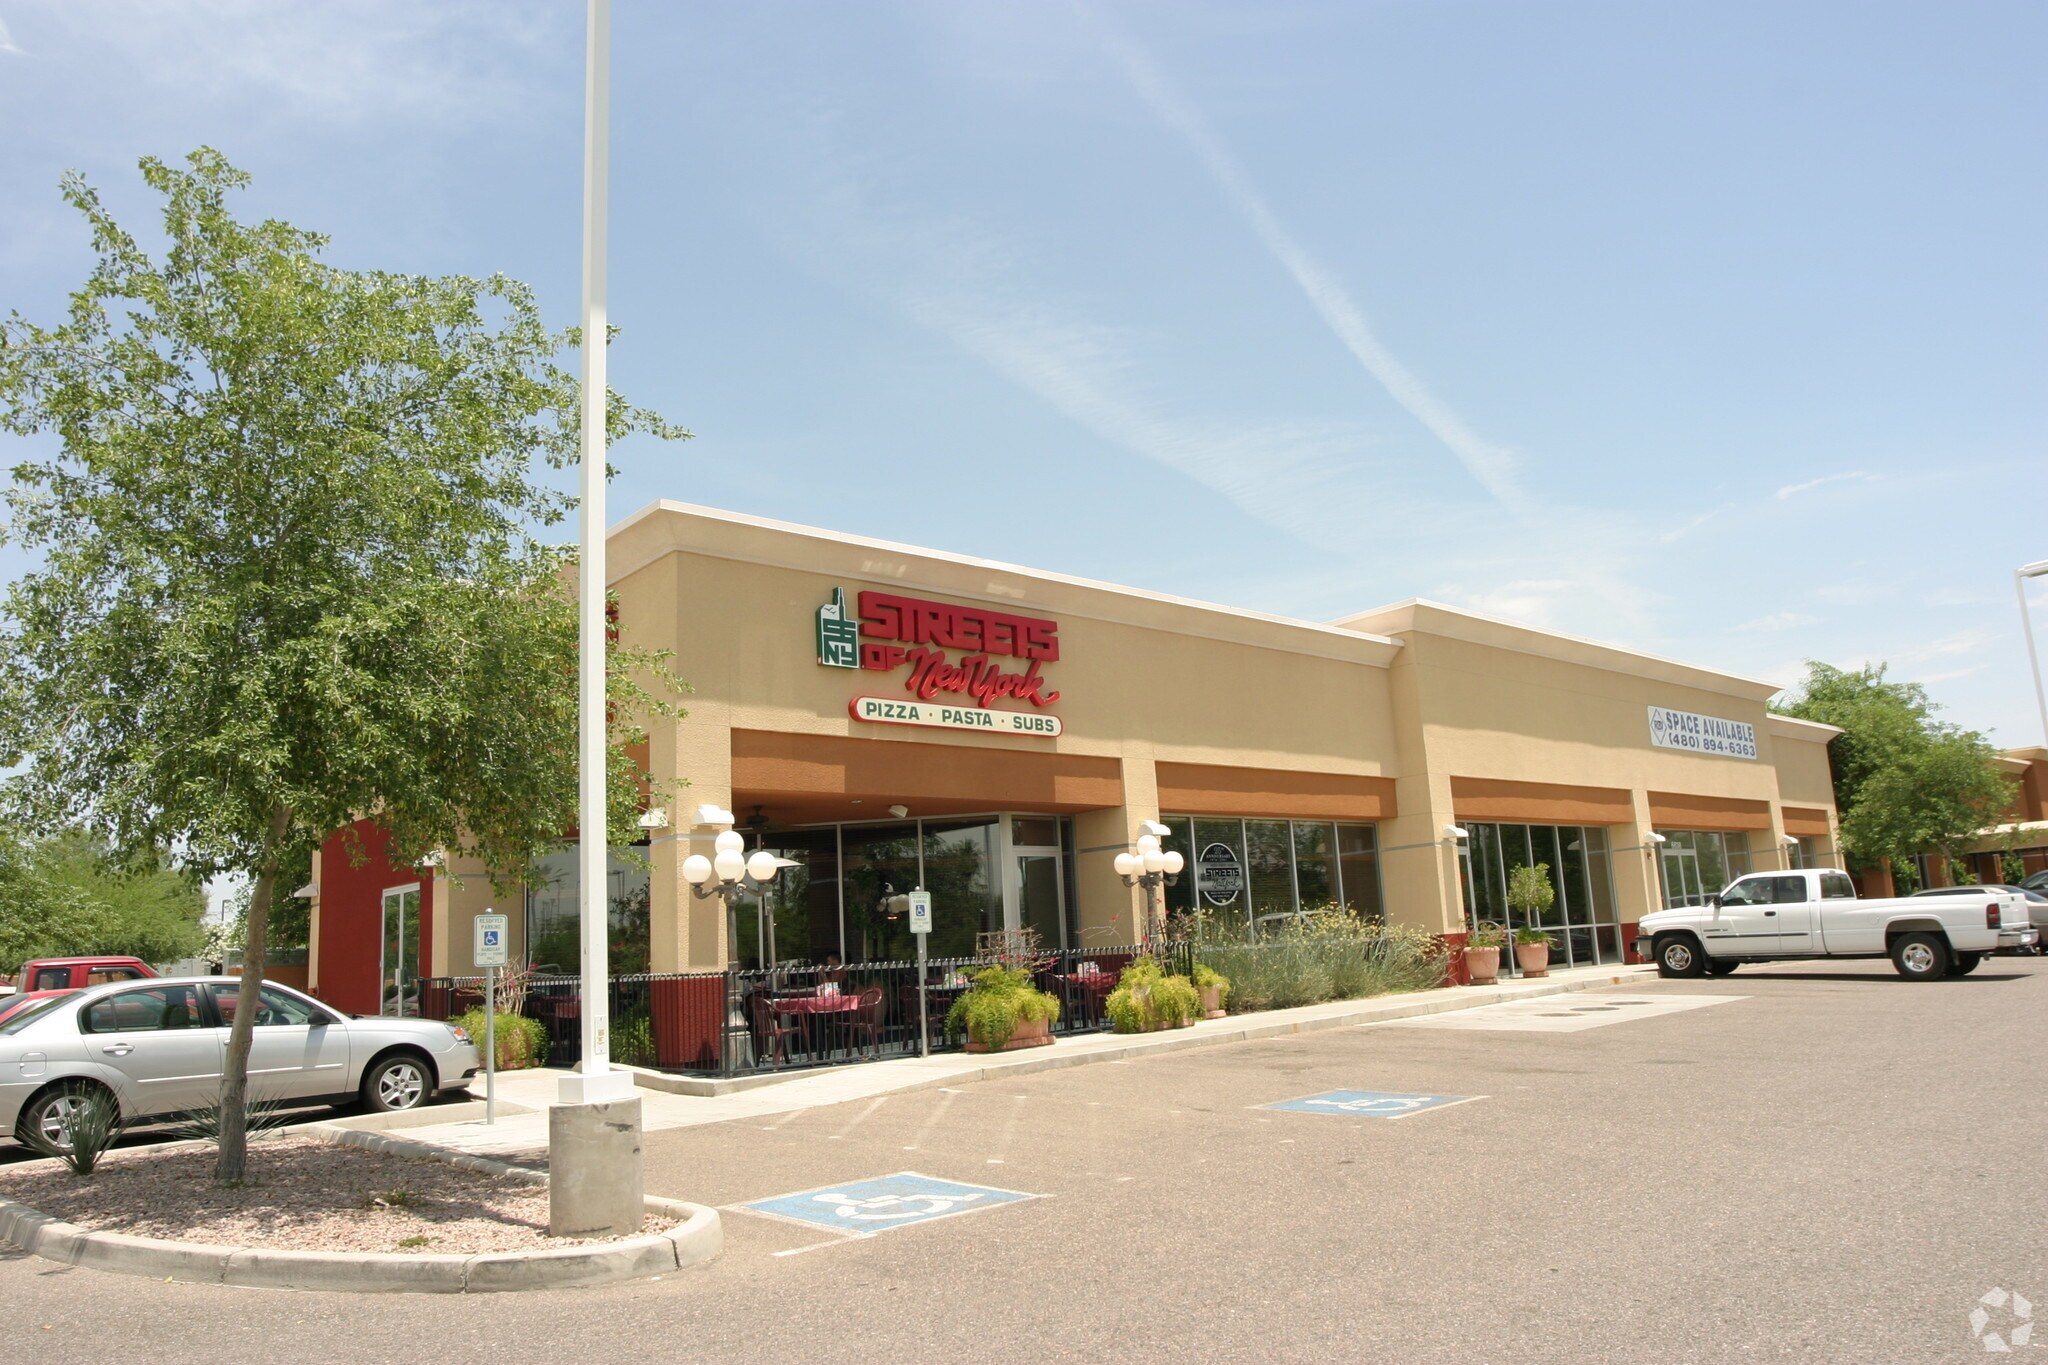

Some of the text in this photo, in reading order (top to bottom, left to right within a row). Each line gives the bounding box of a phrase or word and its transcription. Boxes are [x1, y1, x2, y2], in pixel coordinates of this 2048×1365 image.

[858, 591, 1060, 662] STREETS
[860, 643, 1060, 708] OF New York
[866, 701, 1055, 732] PIZZA PASTA SUBS
[1666, 711, 1700, 735] SPACE
[1703, 718, 1754, 743] AVAILABLE
[1668, 732, 1756, 756] (480) 894-6363
[1206, 868, 1240, 877] STREETS
